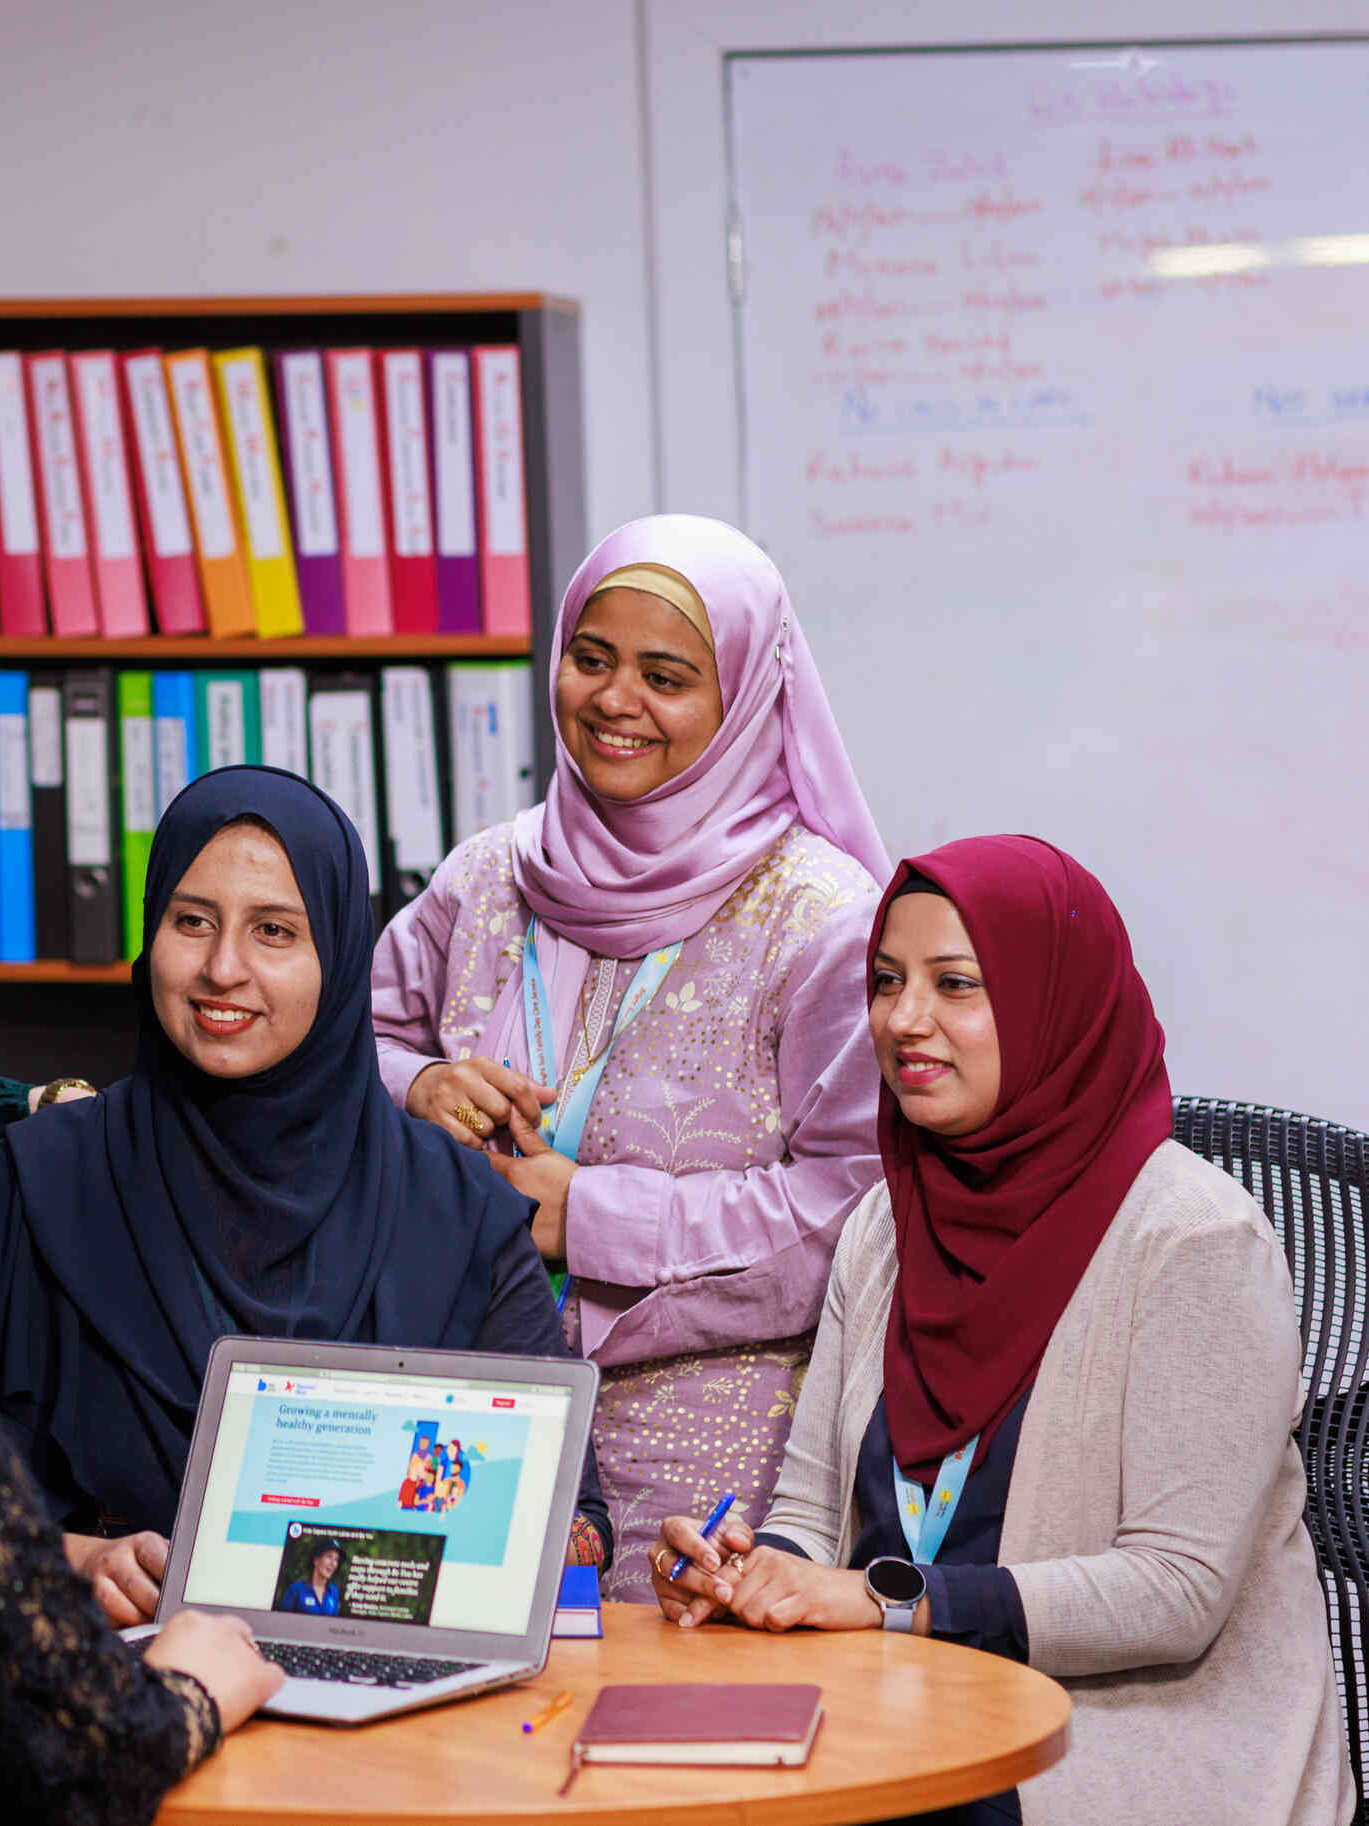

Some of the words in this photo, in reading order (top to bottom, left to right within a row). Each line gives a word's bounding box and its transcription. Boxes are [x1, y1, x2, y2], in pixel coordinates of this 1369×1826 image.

[279, 1404, 322, 1420] Growing
[323, 1409, 330, 1418] a
[332, 1407, 377, 1424] mentally
[276, 1416, 313, 1433] healthy
[315, 1422, 372, 1436] generation
